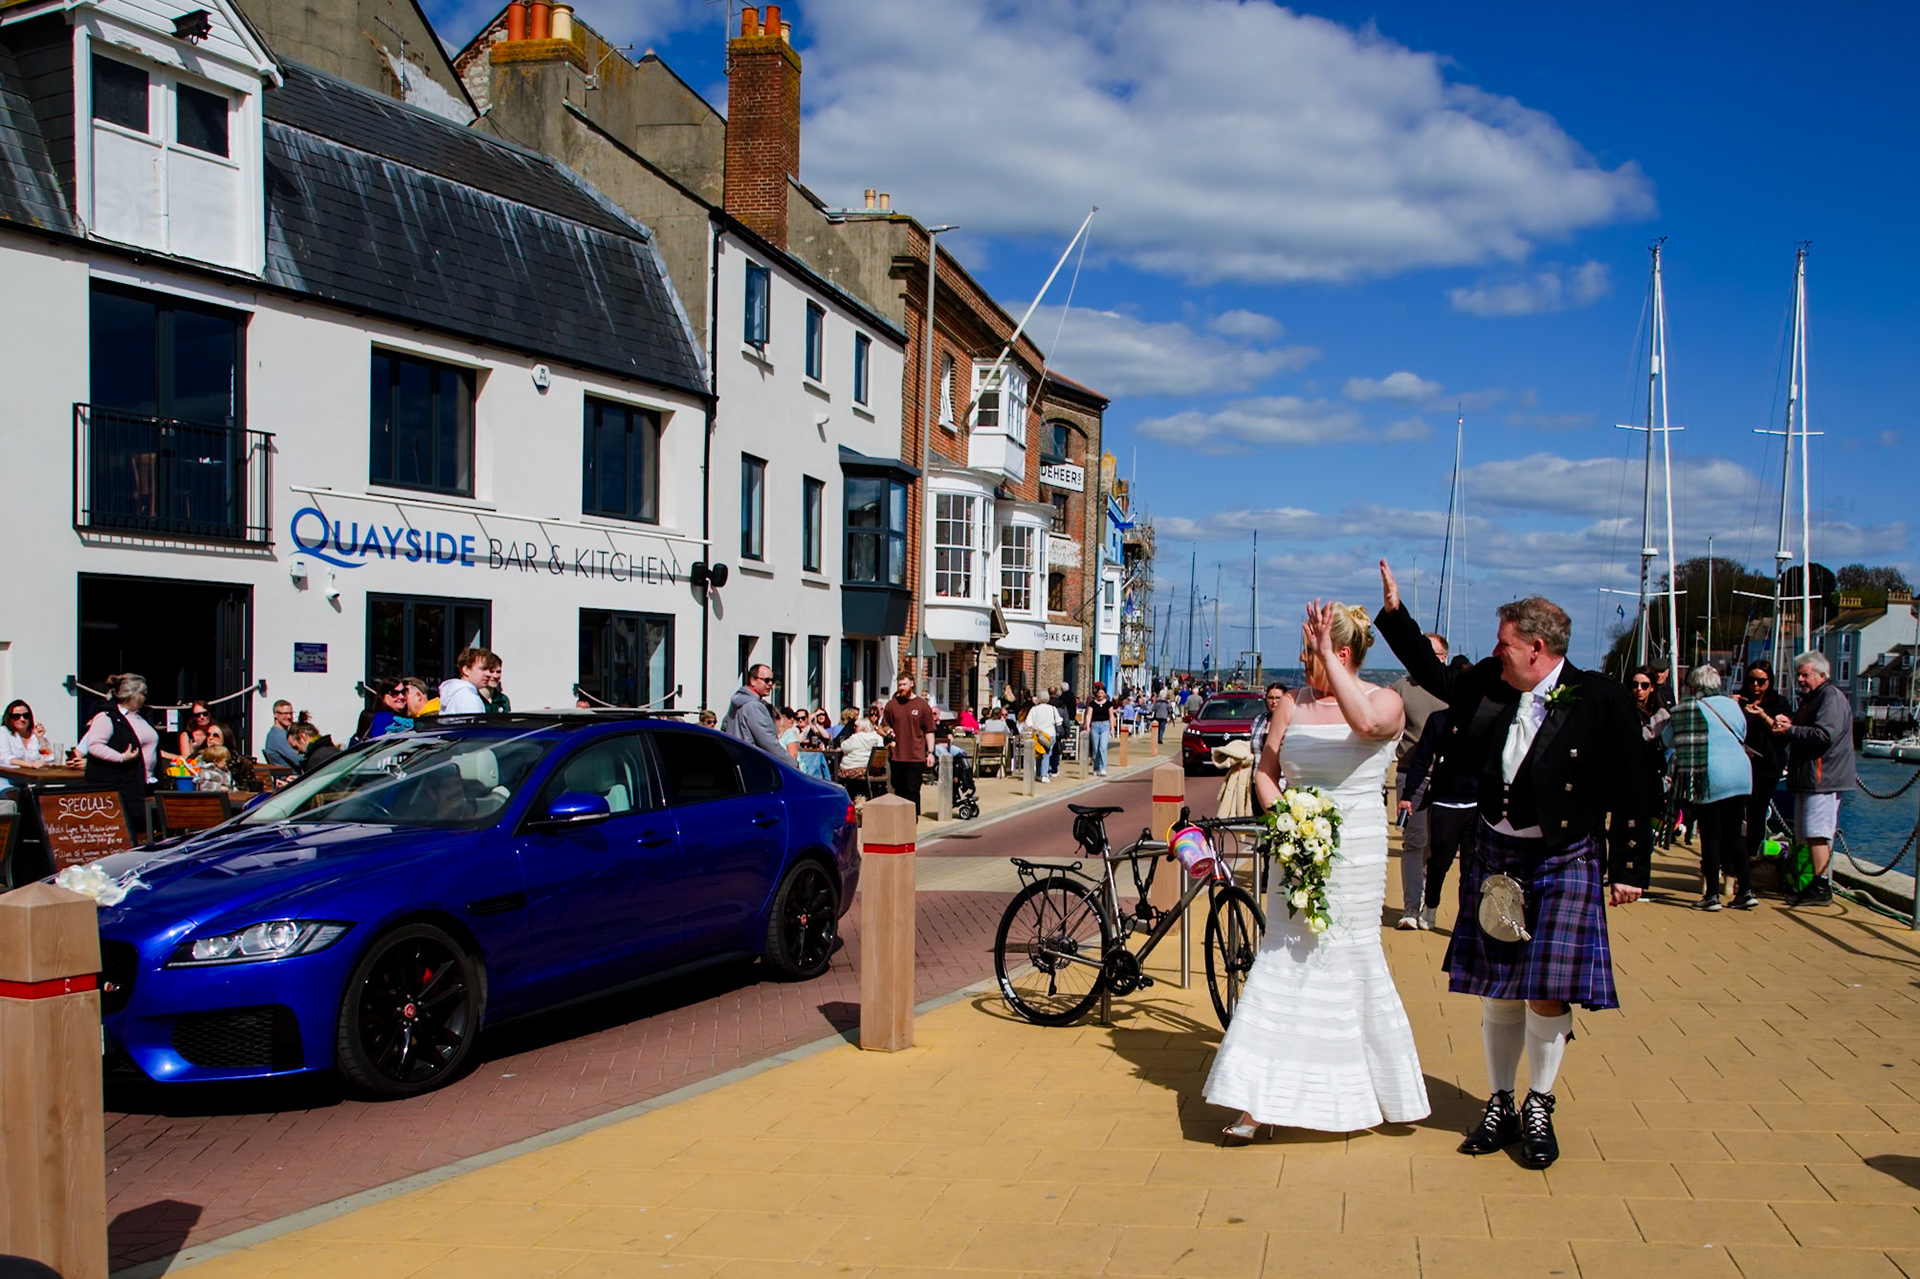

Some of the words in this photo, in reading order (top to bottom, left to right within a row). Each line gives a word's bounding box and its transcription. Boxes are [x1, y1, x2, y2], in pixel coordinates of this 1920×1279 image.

[1041, 465, 1082, 485] DEHEERS
[289, 507, 475, 568] QUAYSIDE
[489, 538, 538, 574] BAR
[548, 545, 565, 575] &
[575, 548, 676, 586] KITCHEN
[1062, 633, 1079, 643] CAFE
[59, 797, 114, 814] SPECIALS
